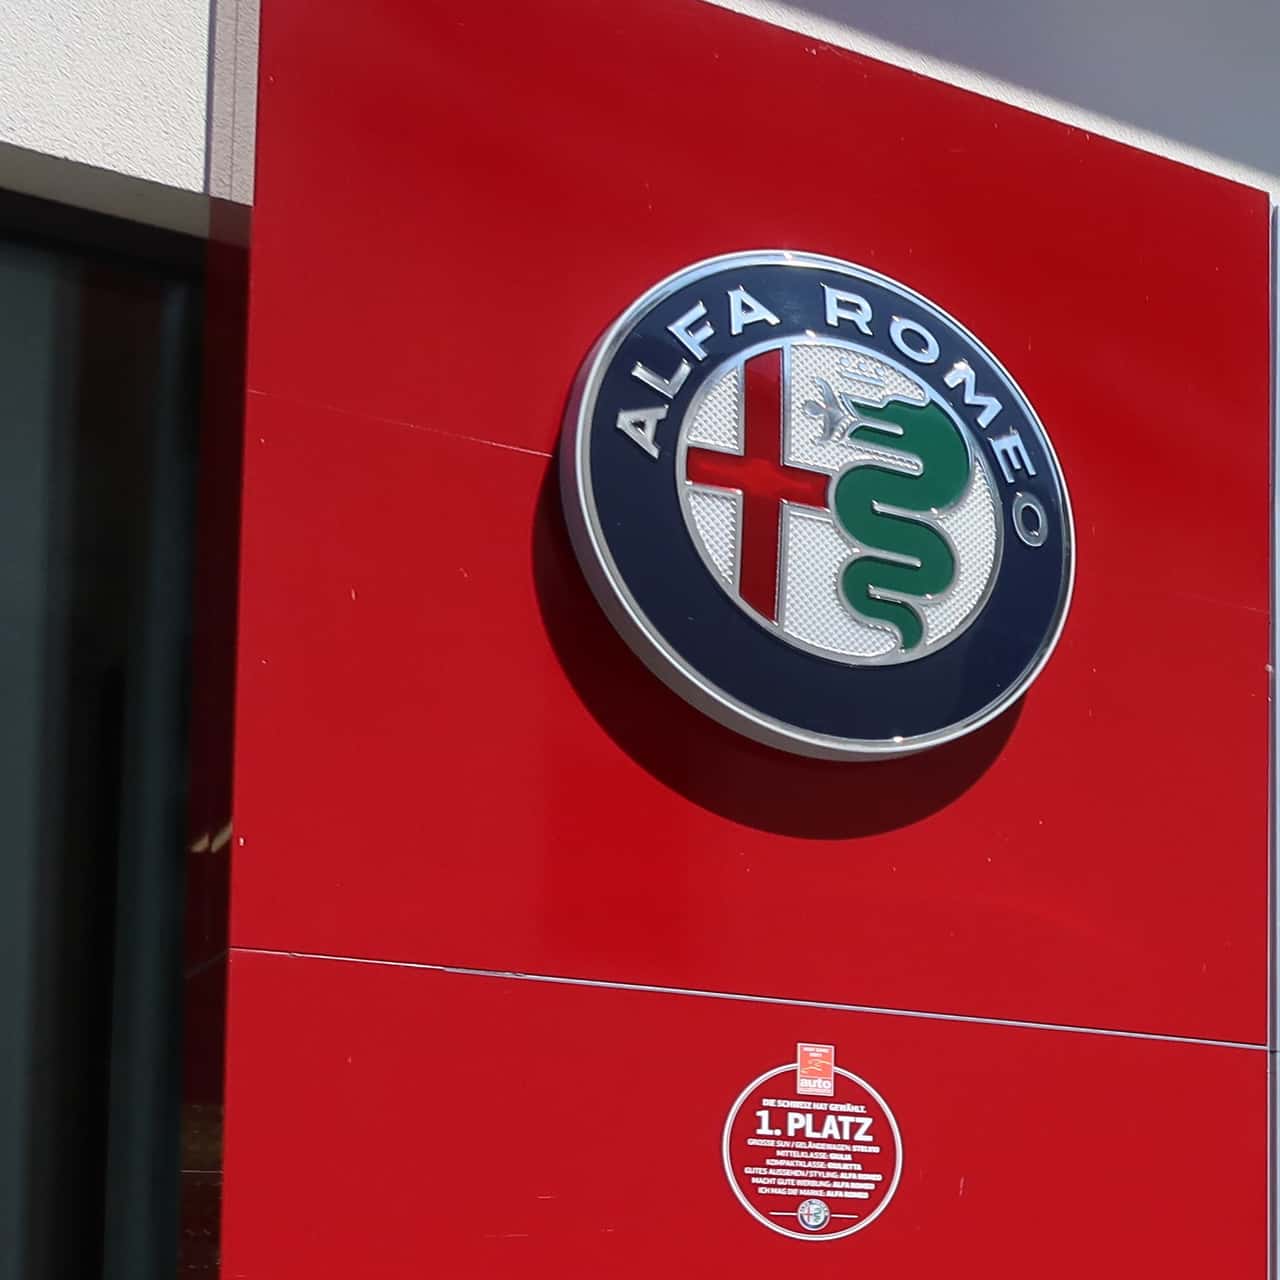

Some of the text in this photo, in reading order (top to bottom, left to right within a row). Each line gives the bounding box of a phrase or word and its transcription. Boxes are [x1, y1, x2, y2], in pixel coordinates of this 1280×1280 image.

[615, 283, 1048, 548] ALFA ROMEO
[799, 1078, 832, 1090] auto
[755, 1110, 874, 1142] 1. PLATZ
